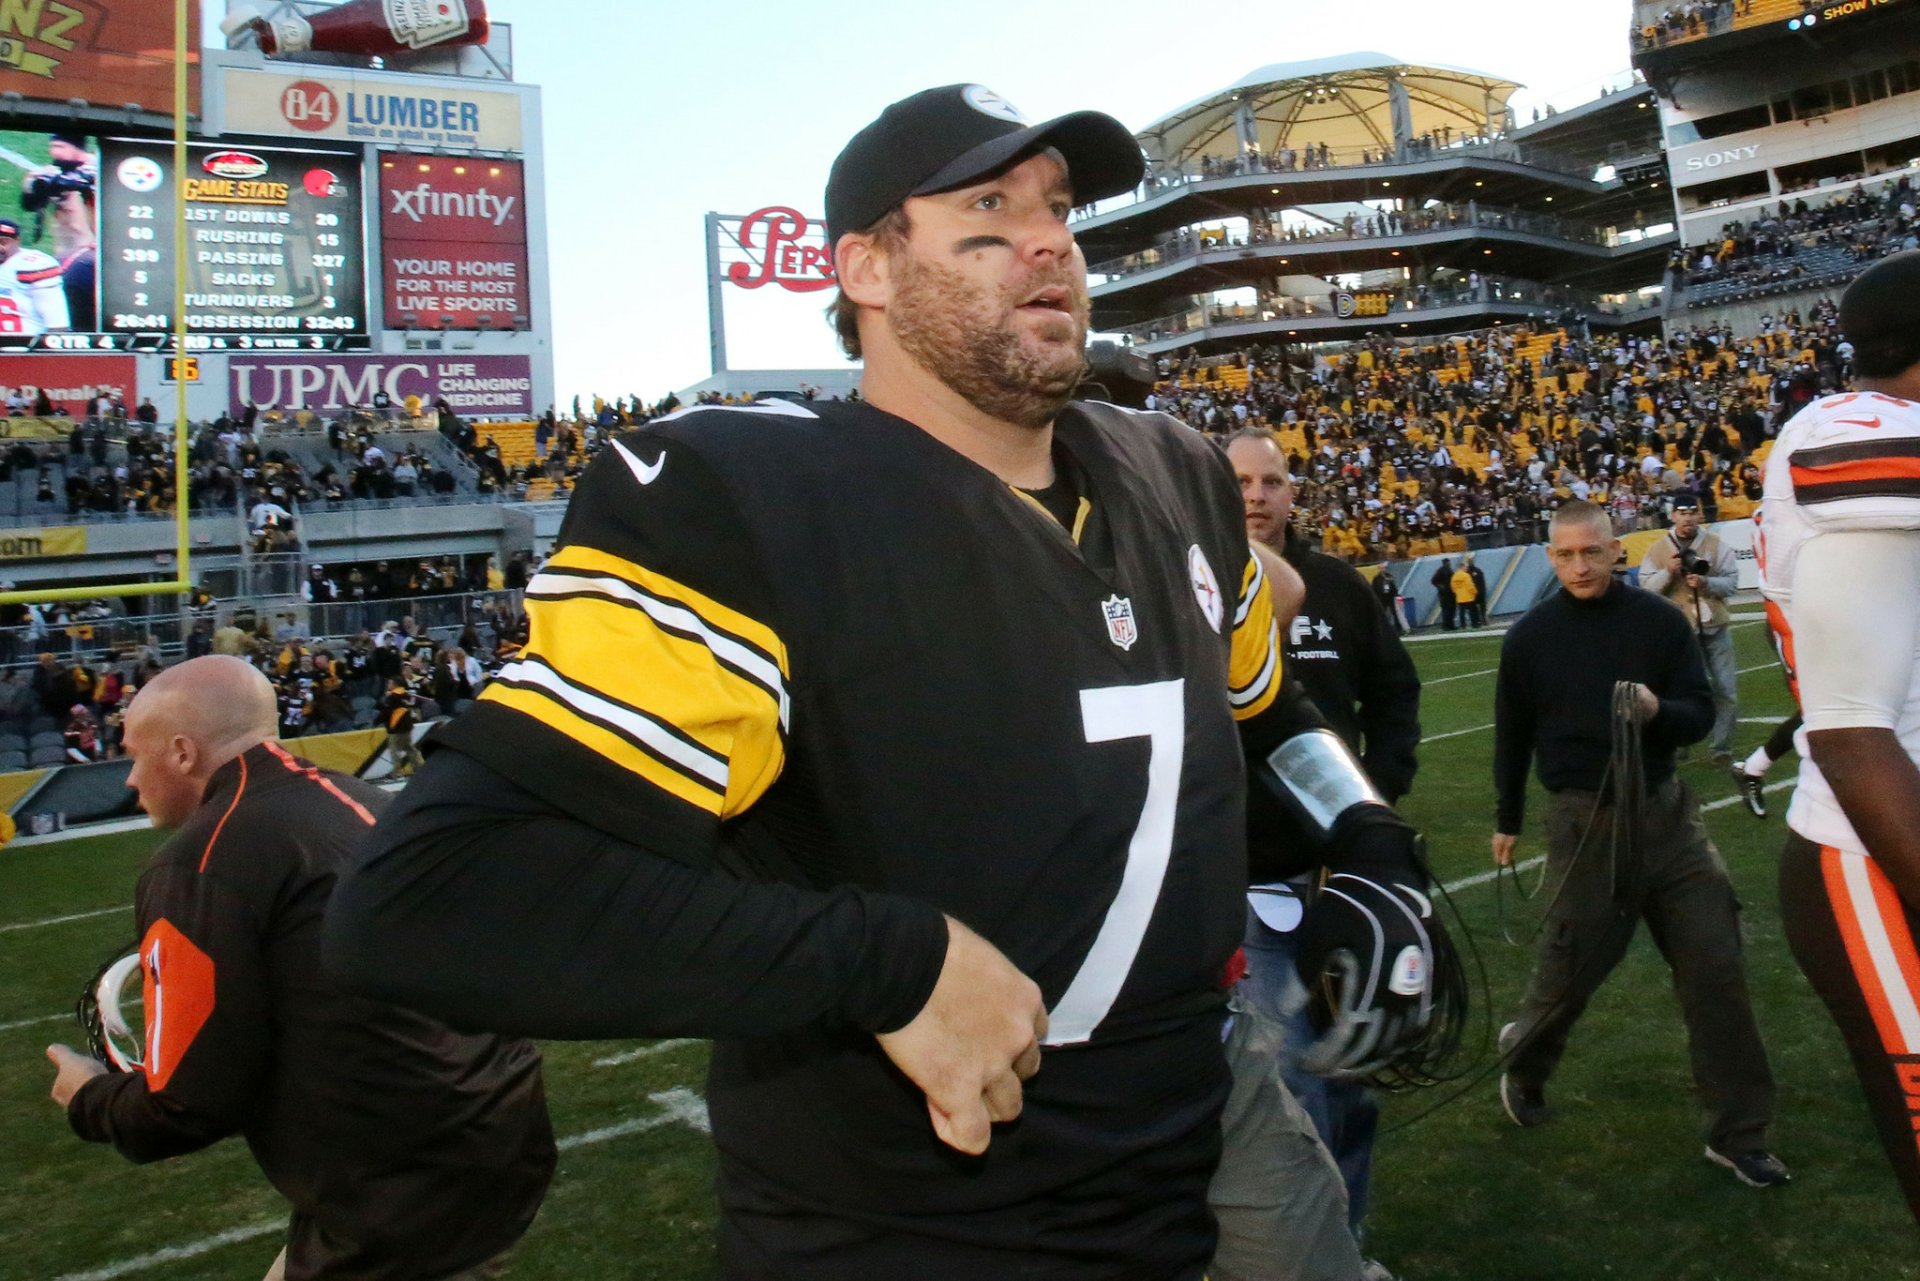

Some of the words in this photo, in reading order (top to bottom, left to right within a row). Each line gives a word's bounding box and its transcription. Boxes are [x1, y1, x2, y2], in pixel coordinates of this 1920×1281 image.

[1823, 0, 1868, 20] SHOW
[285, 88, 333, 122] 84
[347, 92, 479, 132] LUMBER
[1686, 144, 1760, 172] SONY
[184, 178, 235, 200] GAME
[237, 180, 289, 200] STATS
[127, 205, 154, 219] 22
[390, 183, 516, 226] xfinity
[184, 208, 220, 222] 1ST
[225, 210, 291, 225] DOWNS
[315, 213, 340, 227] 20
[196, 229, 284, 246] RUSHING
[316, 233, 340, 247] 15
[197, 250, 285, 266] PASSING
[311, 254, 346, 268] 327
[392, 258, 453, 276] YOUR
[456, 260, 517, 278] HOME
[133, 270, 149, 284] 5
[211, 272, 276, 287] SACKS
[396, 278, 432, 293] FOR
[434, 279, 468, 294] THE
[471, 280, 517, 294] MOST
[133, 292, 149, 307] 2
[184, 293, 295, 309] TURNOVERS
[322, 295, 336, 310] 3
[396, 295, 440, 311] LIVE
[443, 297, 518, 313] SPORTS
[305, 315, 355, 330] 32:43
[44, 334, 91, 350] QTR
[98, 335, 115, 350] 4
[238, 335, 253, 349] 3
[310, 335, 325, 350] 3
[437, 363, 477, 377] LIFE
[230, 363, 431, 411] UPMC
[437, 378, 531, 392] CHANGING
[438, 392, 524, 407] MEDICINE
[1041, 677, 1186, 1047] 7
